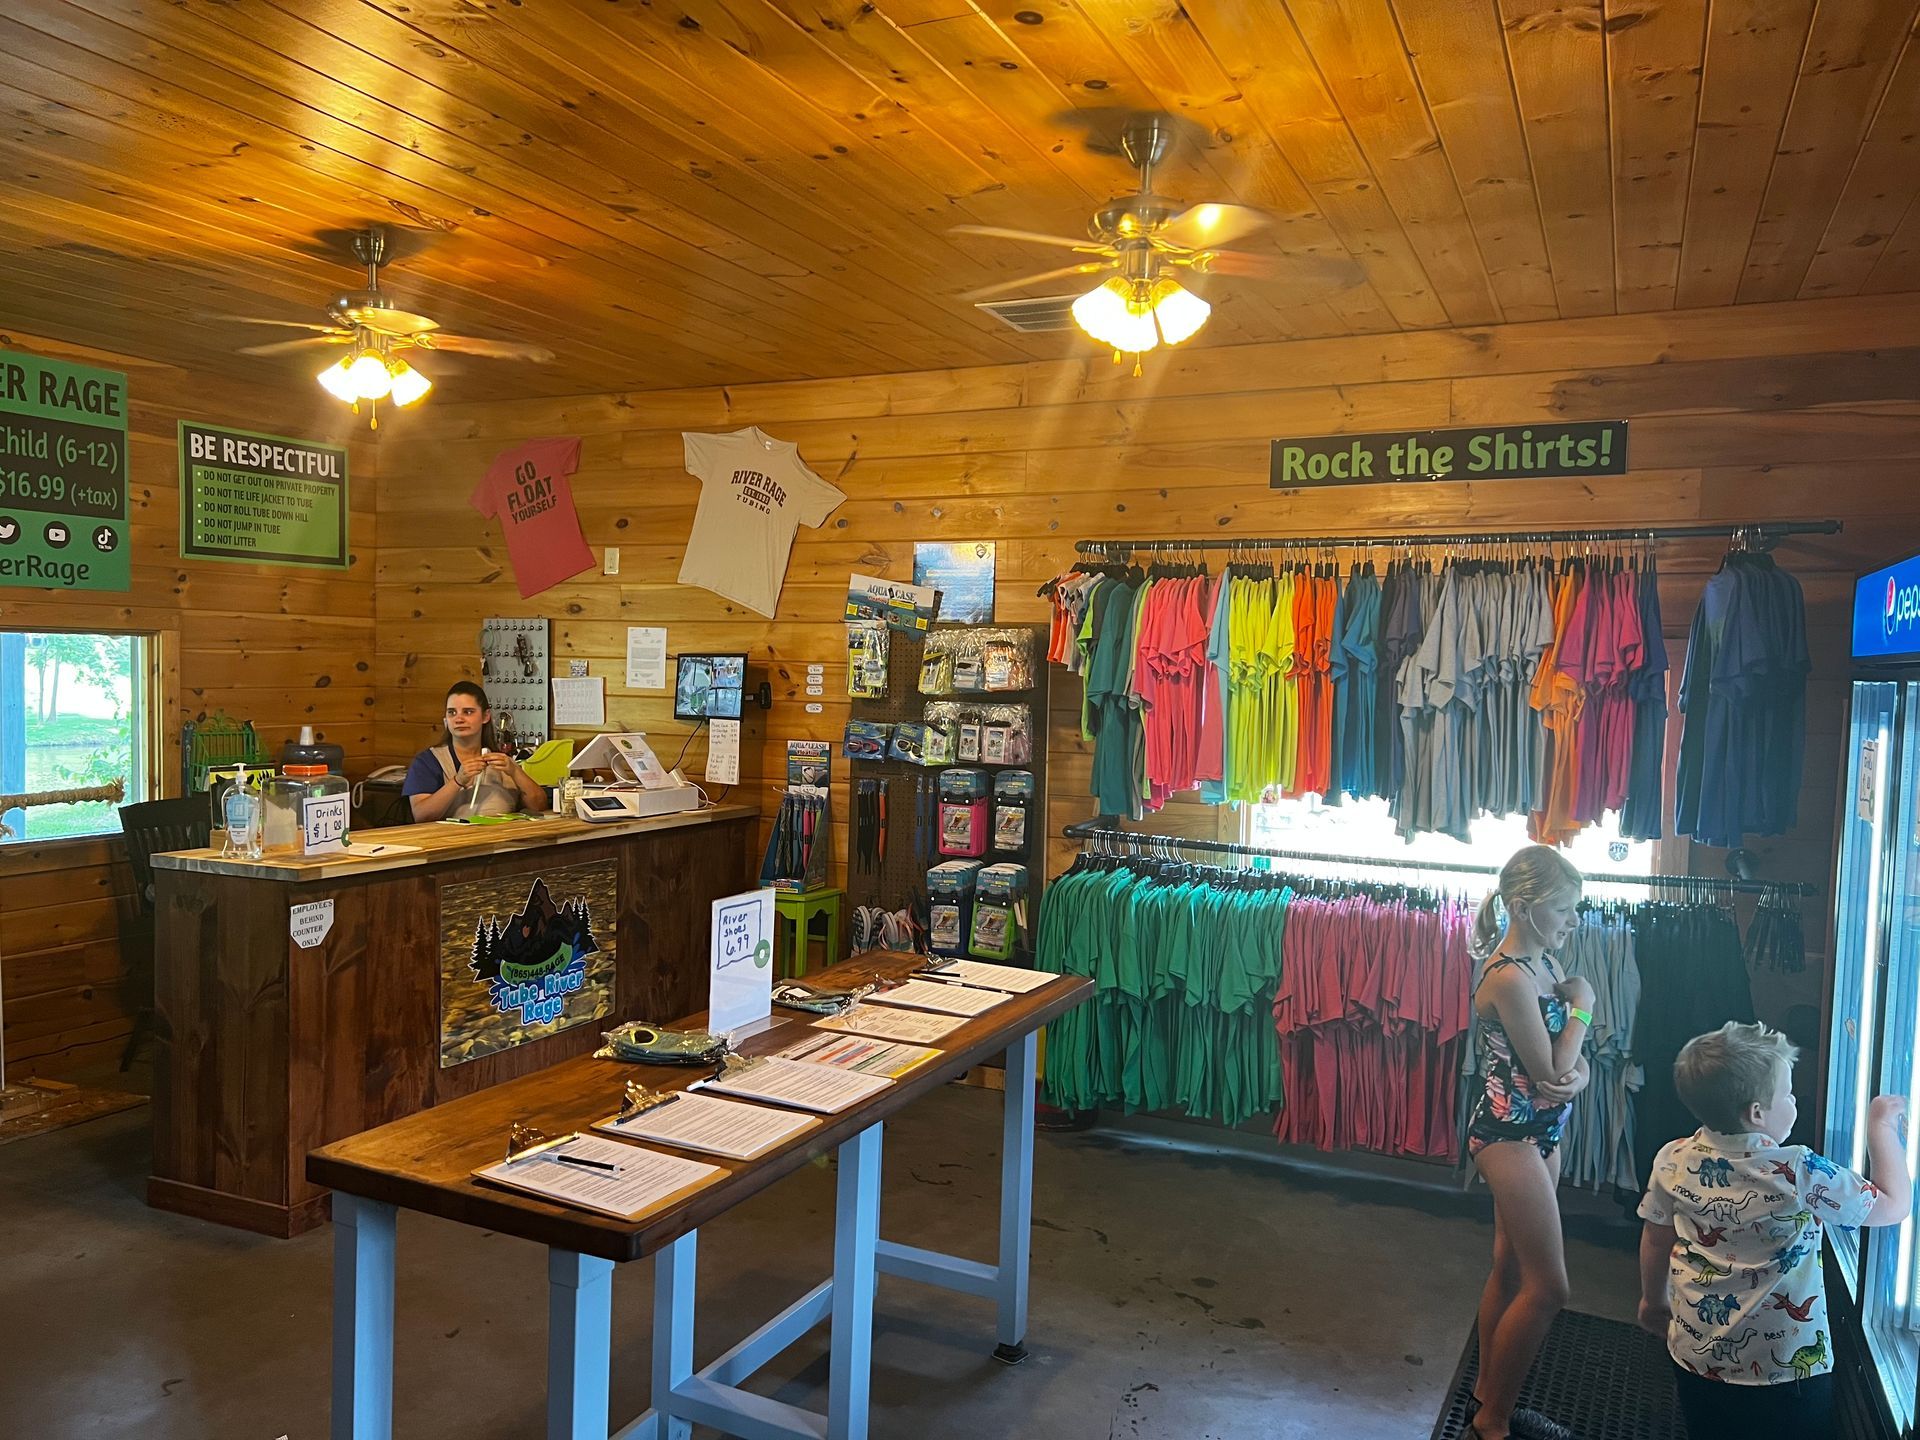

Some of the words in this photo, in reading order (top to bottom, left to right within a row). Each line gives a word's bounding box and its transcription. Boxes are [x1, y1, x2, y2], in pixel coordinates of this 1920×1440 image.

[39, 369, 121, 418] RAGE
[57, 434, 118, 474] (6-12)
[190, 432, 218, 461] BE
[223, 437, 340, 479] RESPECTFUL
[1282, 439, 1374, 481] Rock
[1386, 437, 1454, 475] the
[1467, 429, 1613, 472] Shirts!
[204, 471, 215, 481] DO
[216, 471, 232, 483] NOT
[233, 475, 246, 485] GET
[247, 476, 262, 487] OUT
[263, 478, 275, 489] ON
[275, 480, 303, 493] PRIVATE
[303, 483, 336, 497] PROPERTY
[514, 460, 537, 486] GO
[70, 482, 118, 511] (+tax)
[204, 486, 215, 497] DO
[216, 487, 232, 498] NOT
[233, 489, 244, 500] TIE
[246, 491, 261, 502] LIFE
[261, 493, 286, 506] JACKET
[286, 496, 296, 507] TO
[296, 497, 313, 509] TUBE
[506, 475, 552, 513] FLOAT
[730, 469, 763, 488] RIVER
[762, 475, 787, 508] RAGE
[204, 502, 215, 512] DO
[216, 503, 232, 514] NOT
[233, 504, 251, 515] ROLL
[252, 507, 270, 519] TUBE
[271, 508, 294, 521] DOWN
[294, 511, 309, 523] HILL
[511, 495, 557, 525] YOURSELF
[736, 493, 771, 515] TUBING
[204, 517, 215, 528] DO
[216, 518, 232, 529] NOT
[233, 520, 253, 532] JUMP
[254, 523, 262, 533] IN
[263, 524, 281, 535] TUBE
[204, 533, 215, 544] DO
[216, 534, 232, 545] NOT
[233, 535, 257, 548] LITTER
[867, 583, 889, 597] AQUA
[894, 588, 917, 602] CASE
[789, 741, 806, 750] AQUA
[807, 742, 827, 750] LEASH
[315, 805, 343, 819] Drinks
[292, 925, 324, 937] COUNTER
[299, 914, 325, 925] BEHIND
[722, 913, 748, 925] River
[301, 936, 320, 947] ONLY
[499, 983, 539, 1010] Tube
[543, 969, 585, 997] River
[522, 996, 562, 1024] Rage
